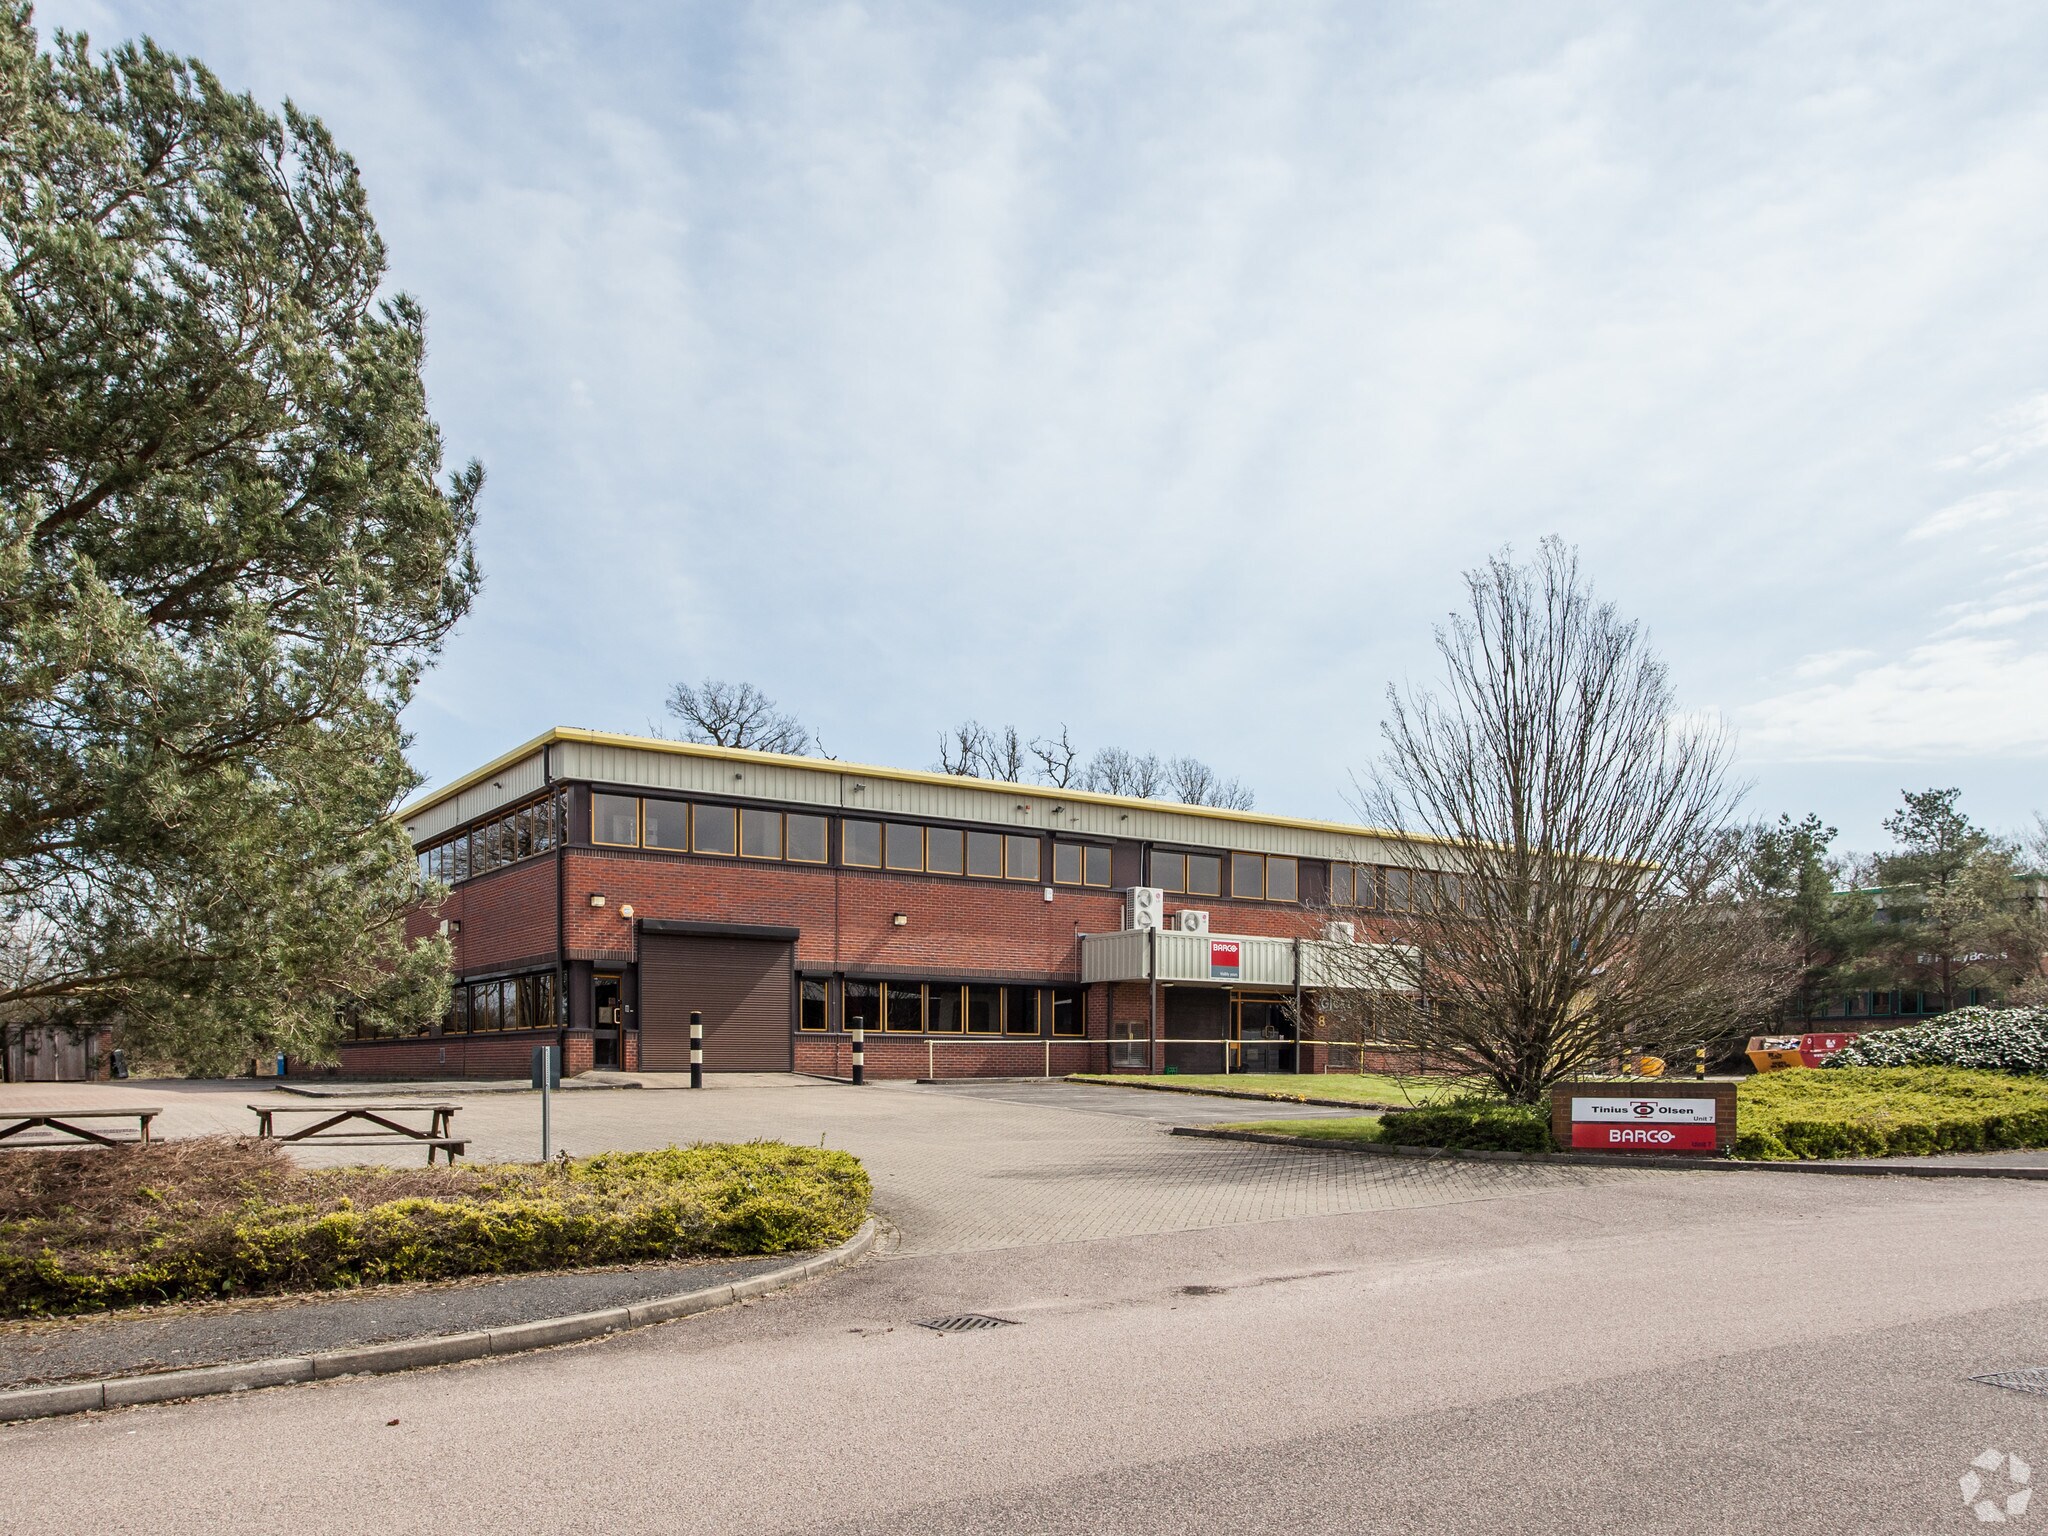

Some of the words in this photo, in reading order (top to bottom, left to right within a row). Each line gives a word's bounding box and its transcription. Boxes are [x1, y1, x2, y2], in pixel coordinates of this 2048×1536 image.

[1213, 944, 1238, 952] BARCO
[1318, 1015, 1326, 1027] 8
[1592, 1106, 1628, 1114] Tinius
[1659, 1106, 1694, 1115] Olsen
[1609, 1129, 1675, 1143] BARCO
